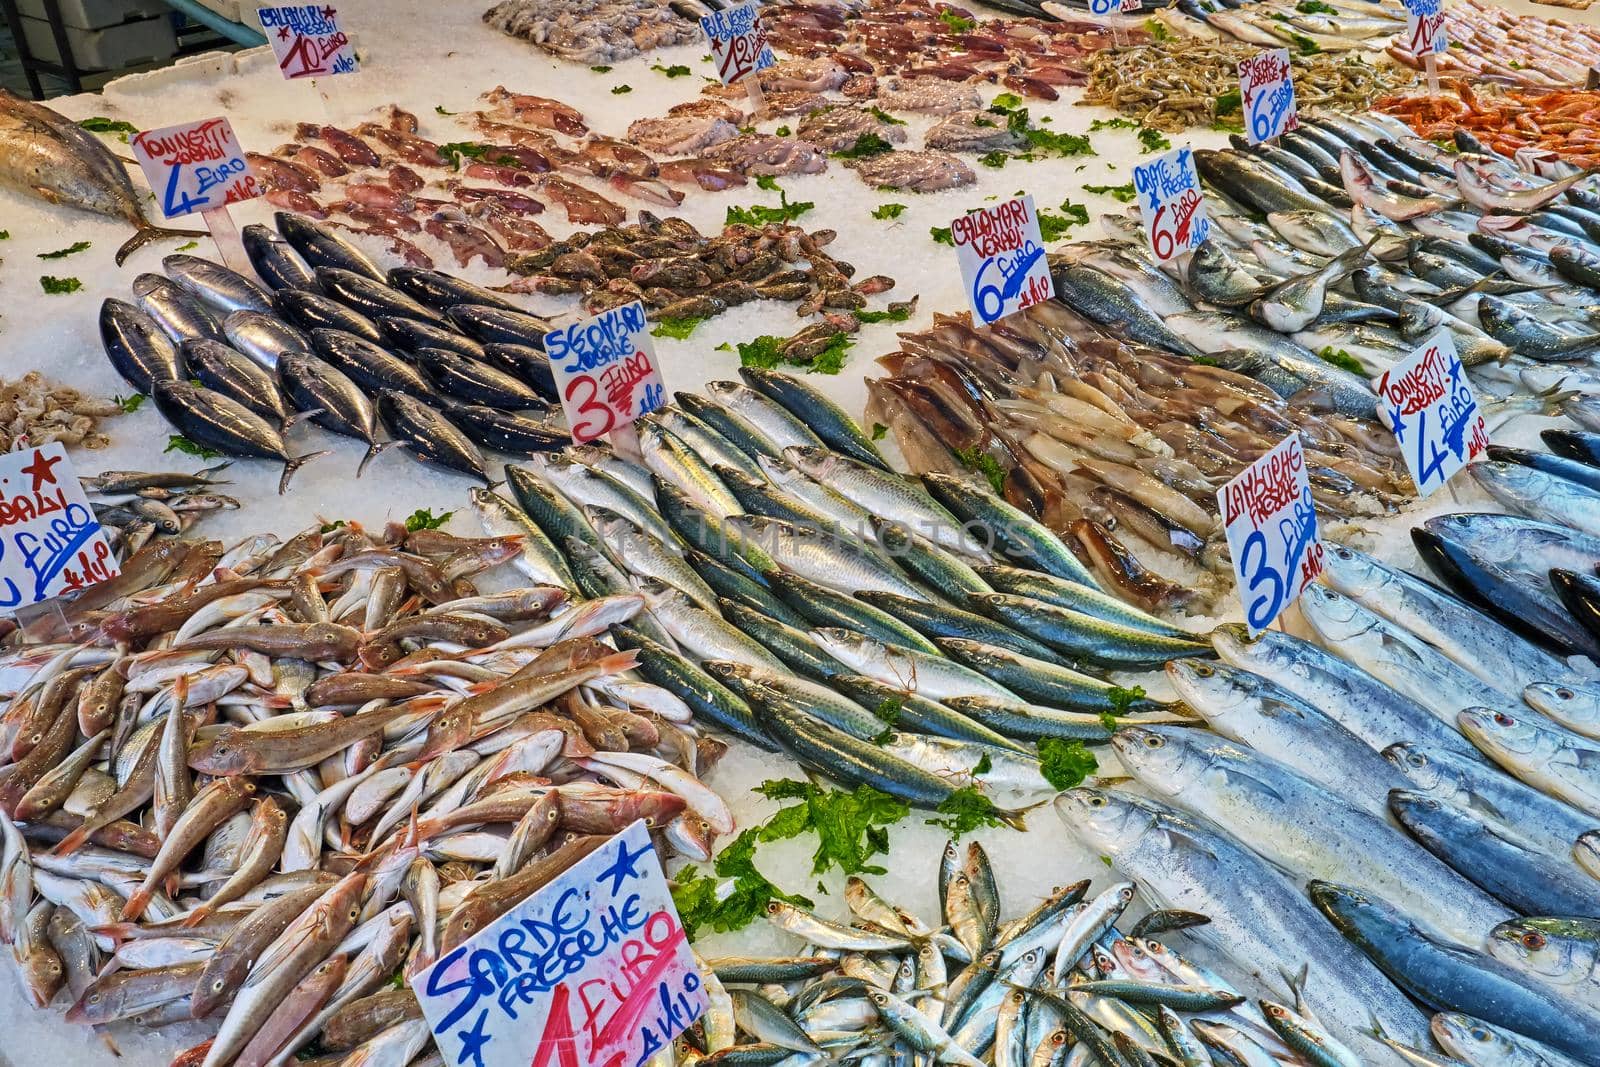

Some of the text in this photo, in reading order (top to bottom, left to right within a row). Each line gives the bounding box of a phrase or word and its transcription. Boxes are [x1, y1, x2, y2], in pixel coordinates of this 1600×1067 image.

[258, 5, 325, 27] CALAMARI
[1411, 12, 1432, 54] 10
[280, 32, 348, 76] 10 EURO
[720, 35, 753, 80] 12
[1253, 89, 1270, 141] 6
[164, 158, 246, 217] 4 EURO
[1134, 159, 1171, 194] ORATE
[951, 199, 1029, 246] CALAMARI
[1152, 189, 1198, 260] 6 EURO
[973, 239, 1037, 325] 6 EURO
[545, 302, 646, 360] SGOMBRO
[564, 336, 635, 373] LOCALE
[565, 351, 652, 442] 3 EURO
[1418, 386, 1472, 486] 4 EURO
[15, 503, 91, 570] EURO
[1240, 486, 1314, 630] 3 EURO
[498, 893, 650, 1020] FRESCHE
[578, 911, 677, 1038] EURO
